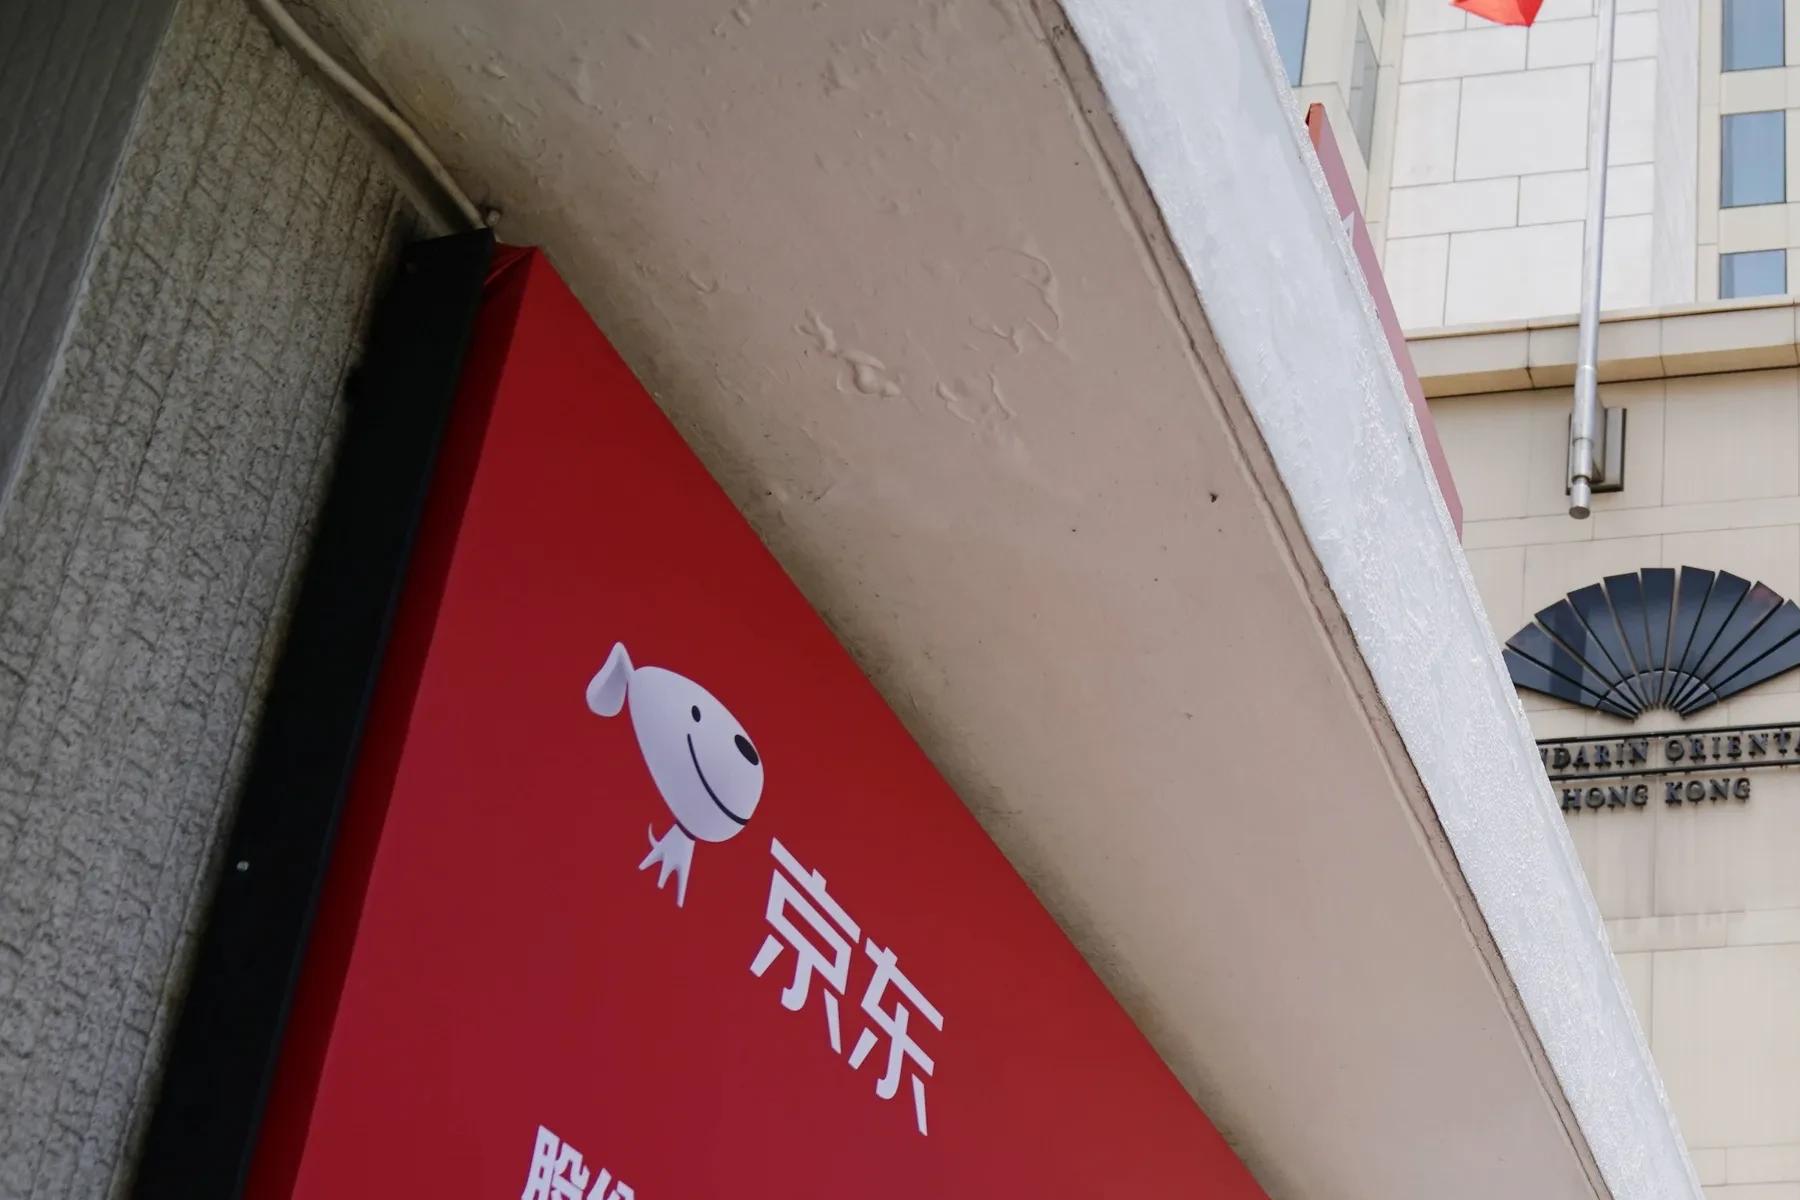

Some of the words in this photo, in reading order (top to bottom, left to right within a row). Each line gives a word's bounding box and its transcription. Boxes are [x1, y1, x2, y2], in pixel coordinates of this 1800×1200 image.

[1561, 784, 1648, 812] HONG
[1665, 777, 1750, 806] KONG
[750, 837, 944, 1136] 京东
